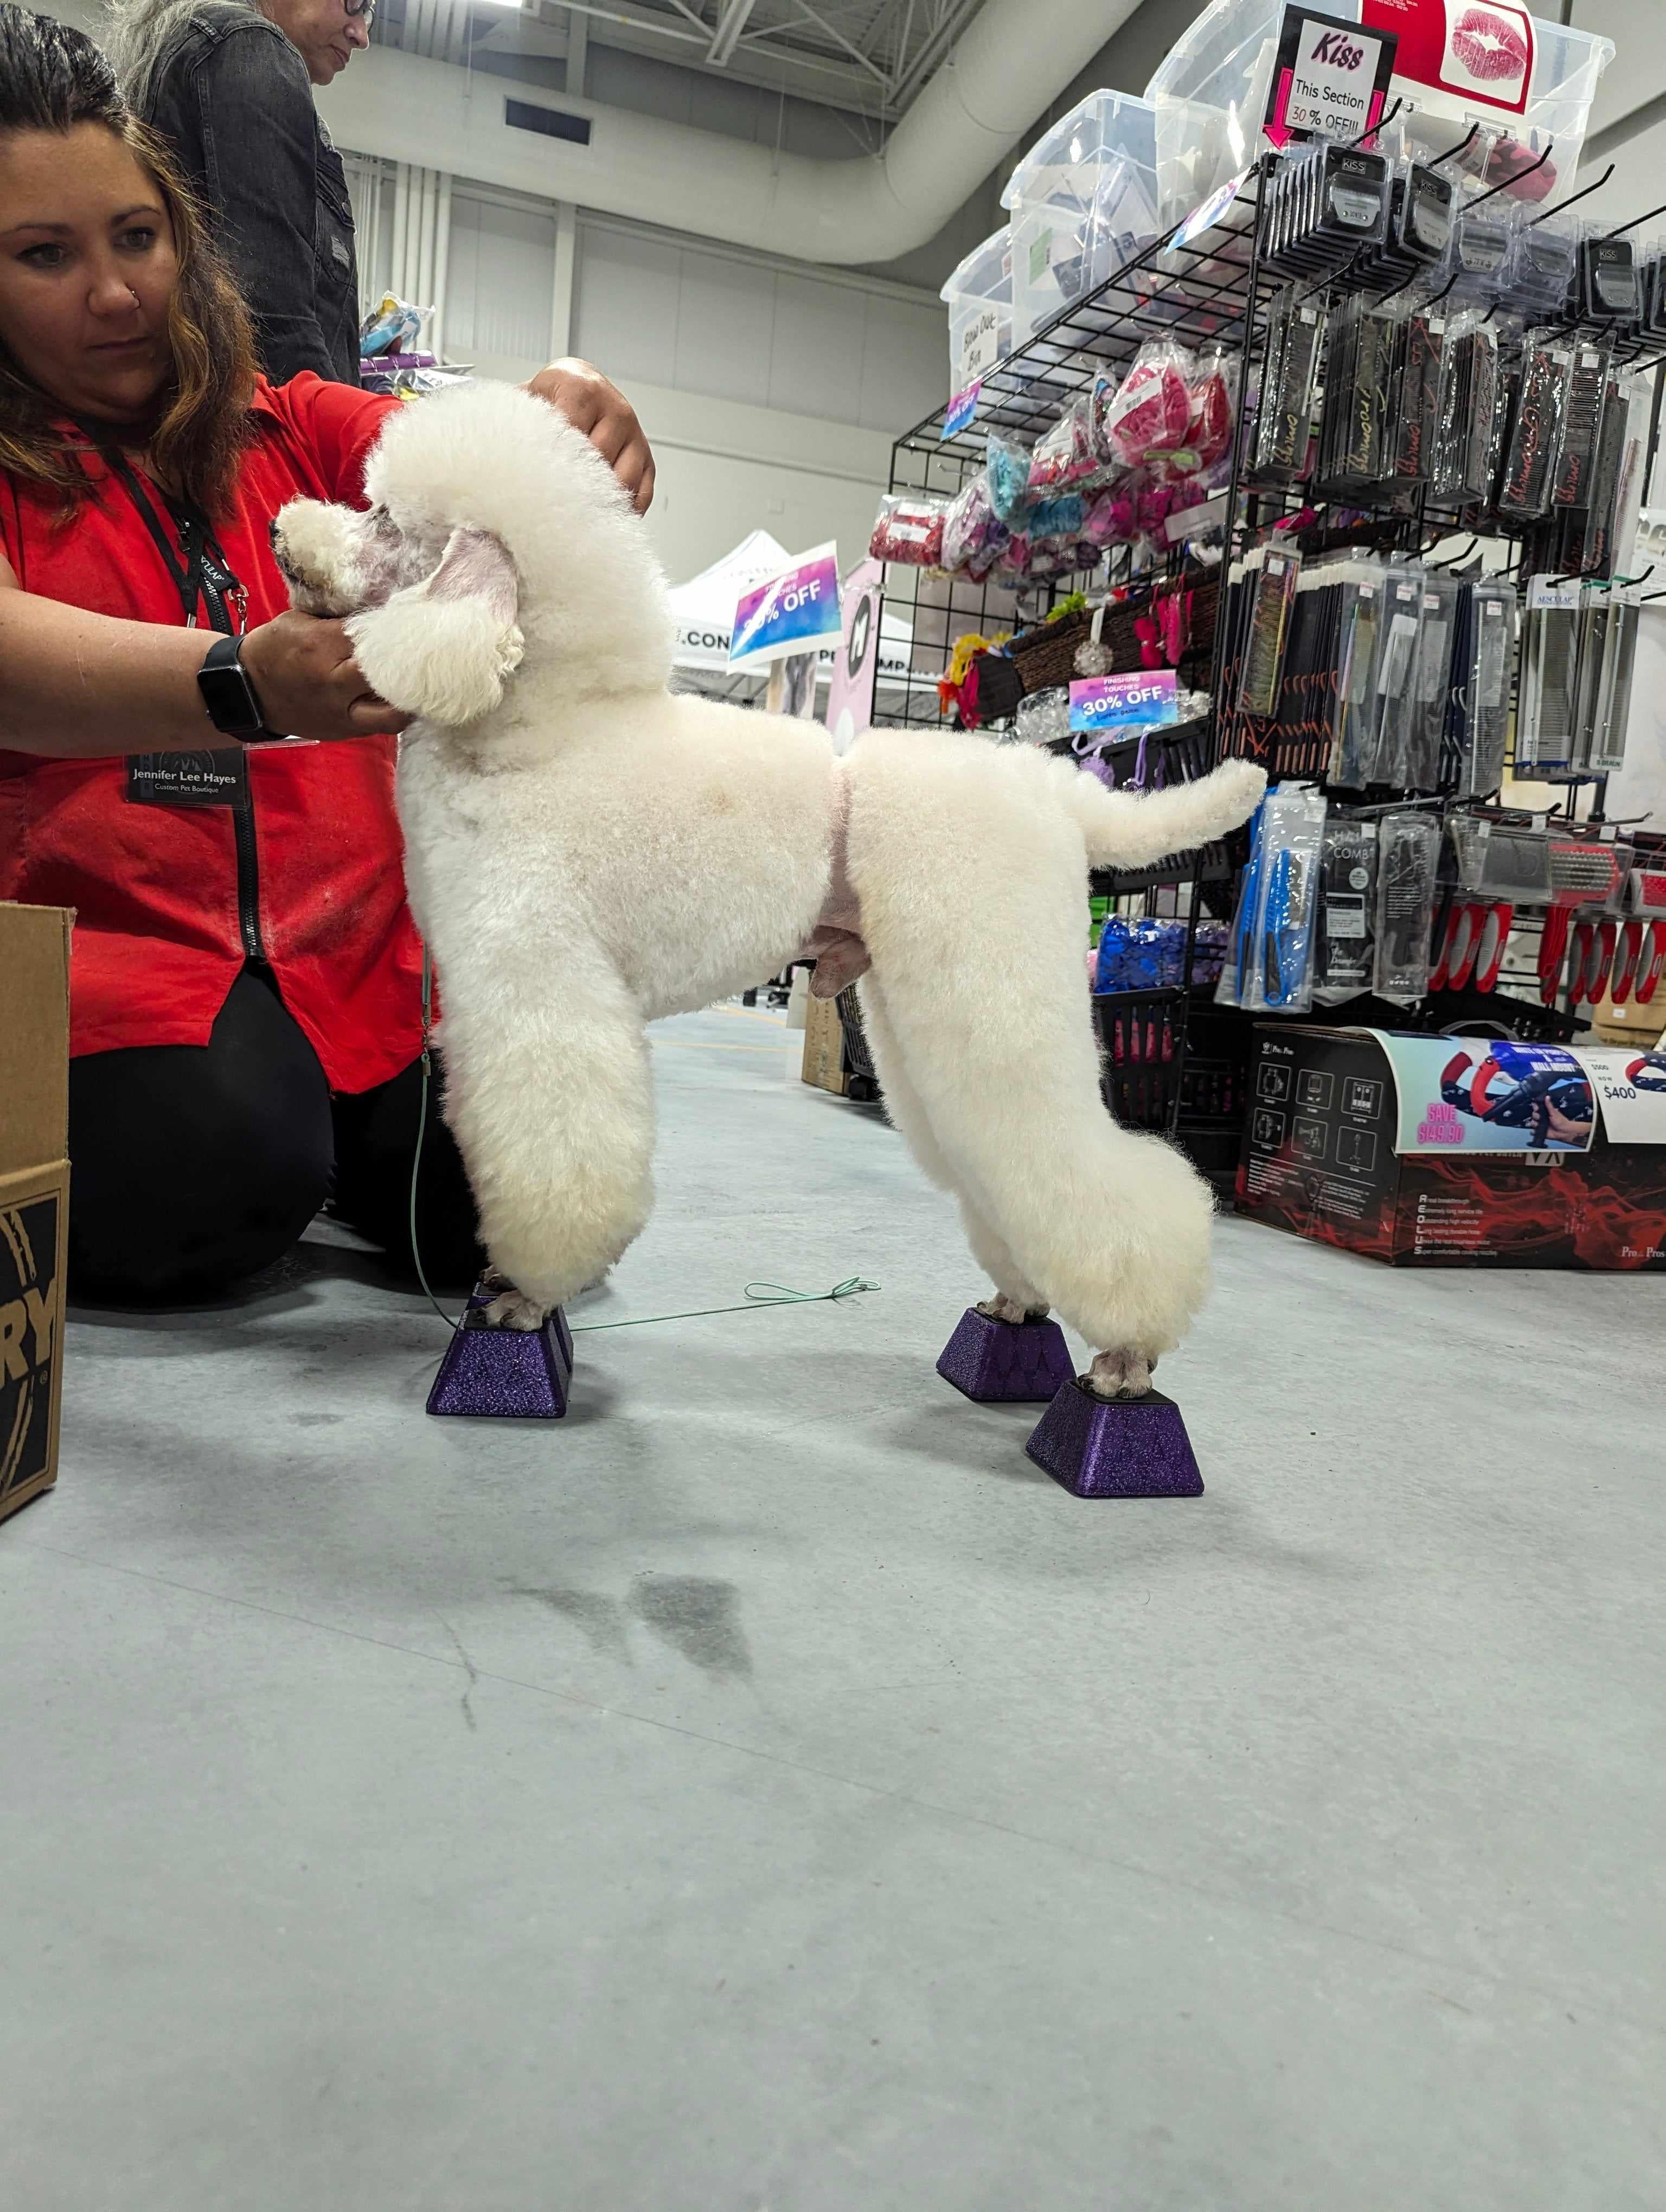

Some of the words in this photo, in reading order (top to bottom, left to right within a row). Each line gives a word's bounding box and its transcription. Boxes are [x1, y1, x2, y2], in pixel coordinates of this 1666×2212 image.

[1311, 33, 1363, 70] Kiss
[1296, 79, 1319, 98] This
[1322, 87, 1364, 110] Section
[1292, 107, 1306, 122] 30
[1310, 110, 1321, 125] %
[1343, 159, 1365, 171] KISS
[1600, 249, 1617, 259] KISS
[783, 578, 821, 612] OFF
[1104, 675, 1140, 685] FINISHING
[1104, 685, 1138, 693] TOUCHES
[1082, 695, 1123, 716] 30%
[1126, 685, 1162, 704] OFF
[133, 769, 177, 781] Jennifer
[180, 771, 201, 782] Lee
[203, 773, 236, 785] Hayes
[192, 786, 219, 794] Boutique
[1334, 847, 1368, 860] COMB
[1604, 1085, 1637, 1099] $400
[1427, 1104, 1456, 1123] SAVE
[1417, 1123, 1463, 1144] $149.90
[1622, 1246, 1637, 1258] Pro
[1646, 1246, 1665, 1258] Pros
